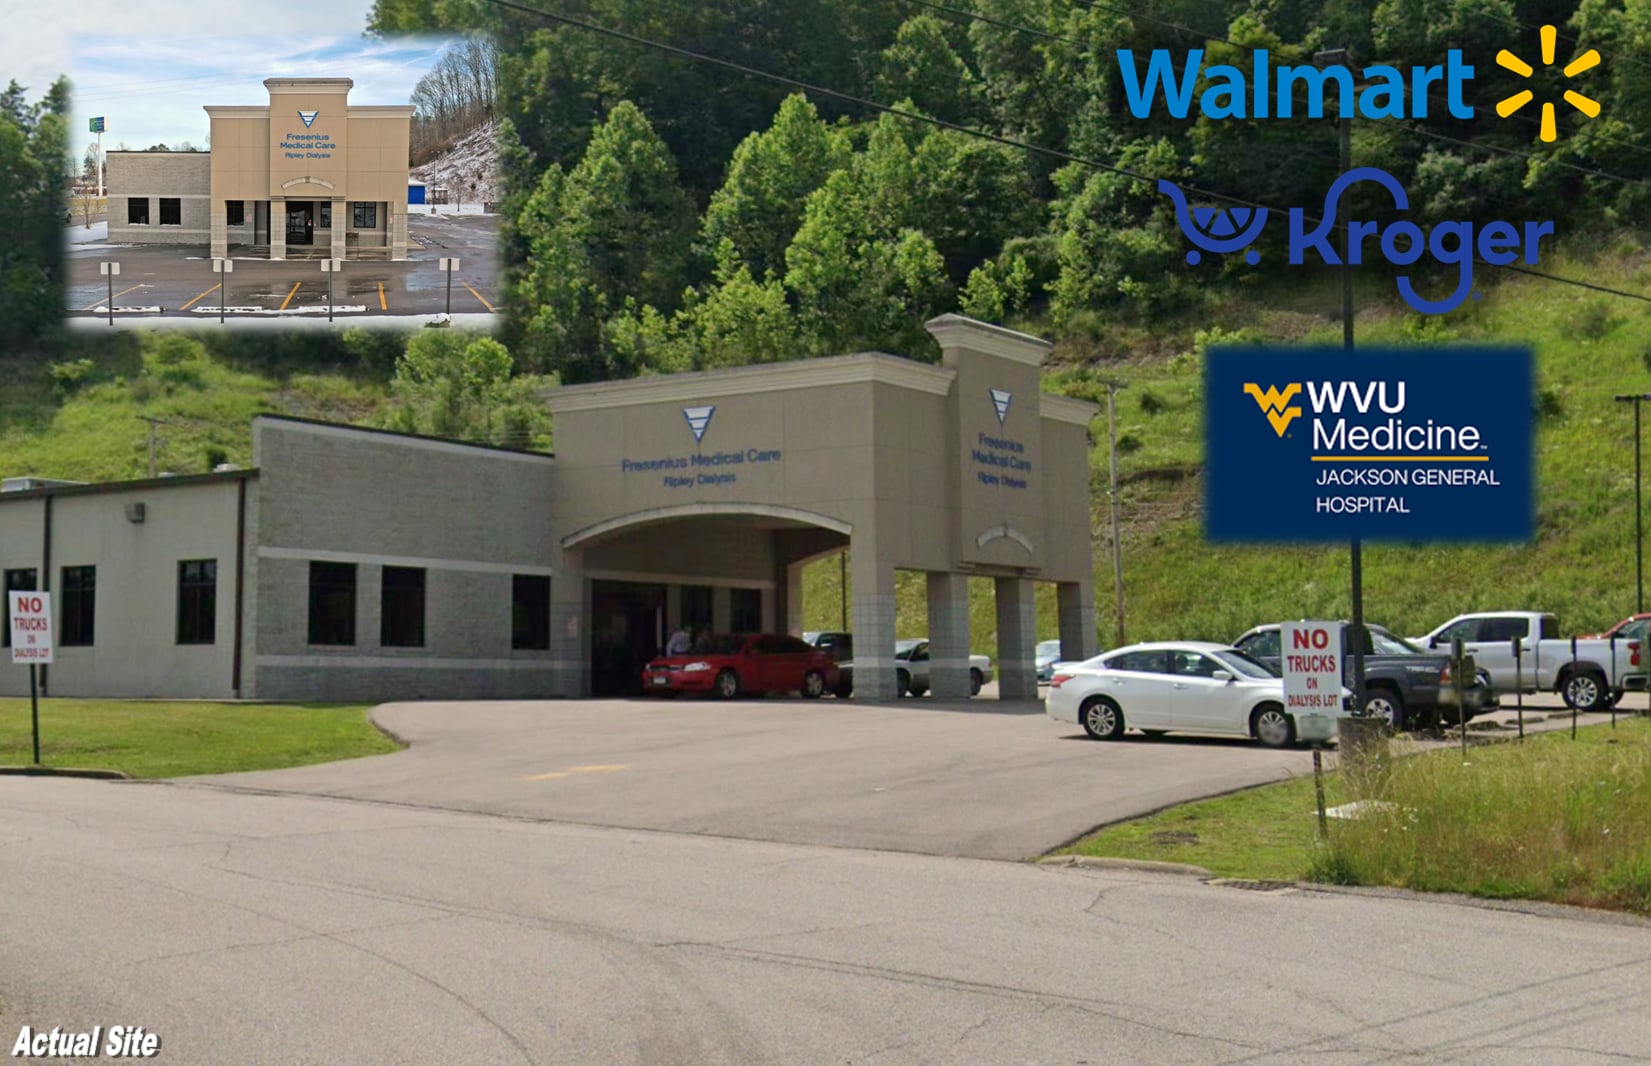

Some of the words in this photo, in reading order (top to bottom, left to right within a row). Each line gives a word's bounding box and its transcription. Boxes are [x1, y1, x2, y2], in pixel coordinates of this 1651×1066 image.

[286, 133, 330, 141] Fresenius
[621, 457, 688, 472] Fresenius
[691, 452, 744, 467] Medical
[747, 448, 782, 463] Care
[18, 597, 42, 613] NO
[14, 617, 48, 631] TRUCKS
[1292, 628, 1329, 650] NO
[1286, 655, 1336, 673] TRUCKS
[1306, 677, 1318, 689] ON
[1288, 694, 1321, 707] DIALYSIS
[1323, 694, 1338, 707] LOT
